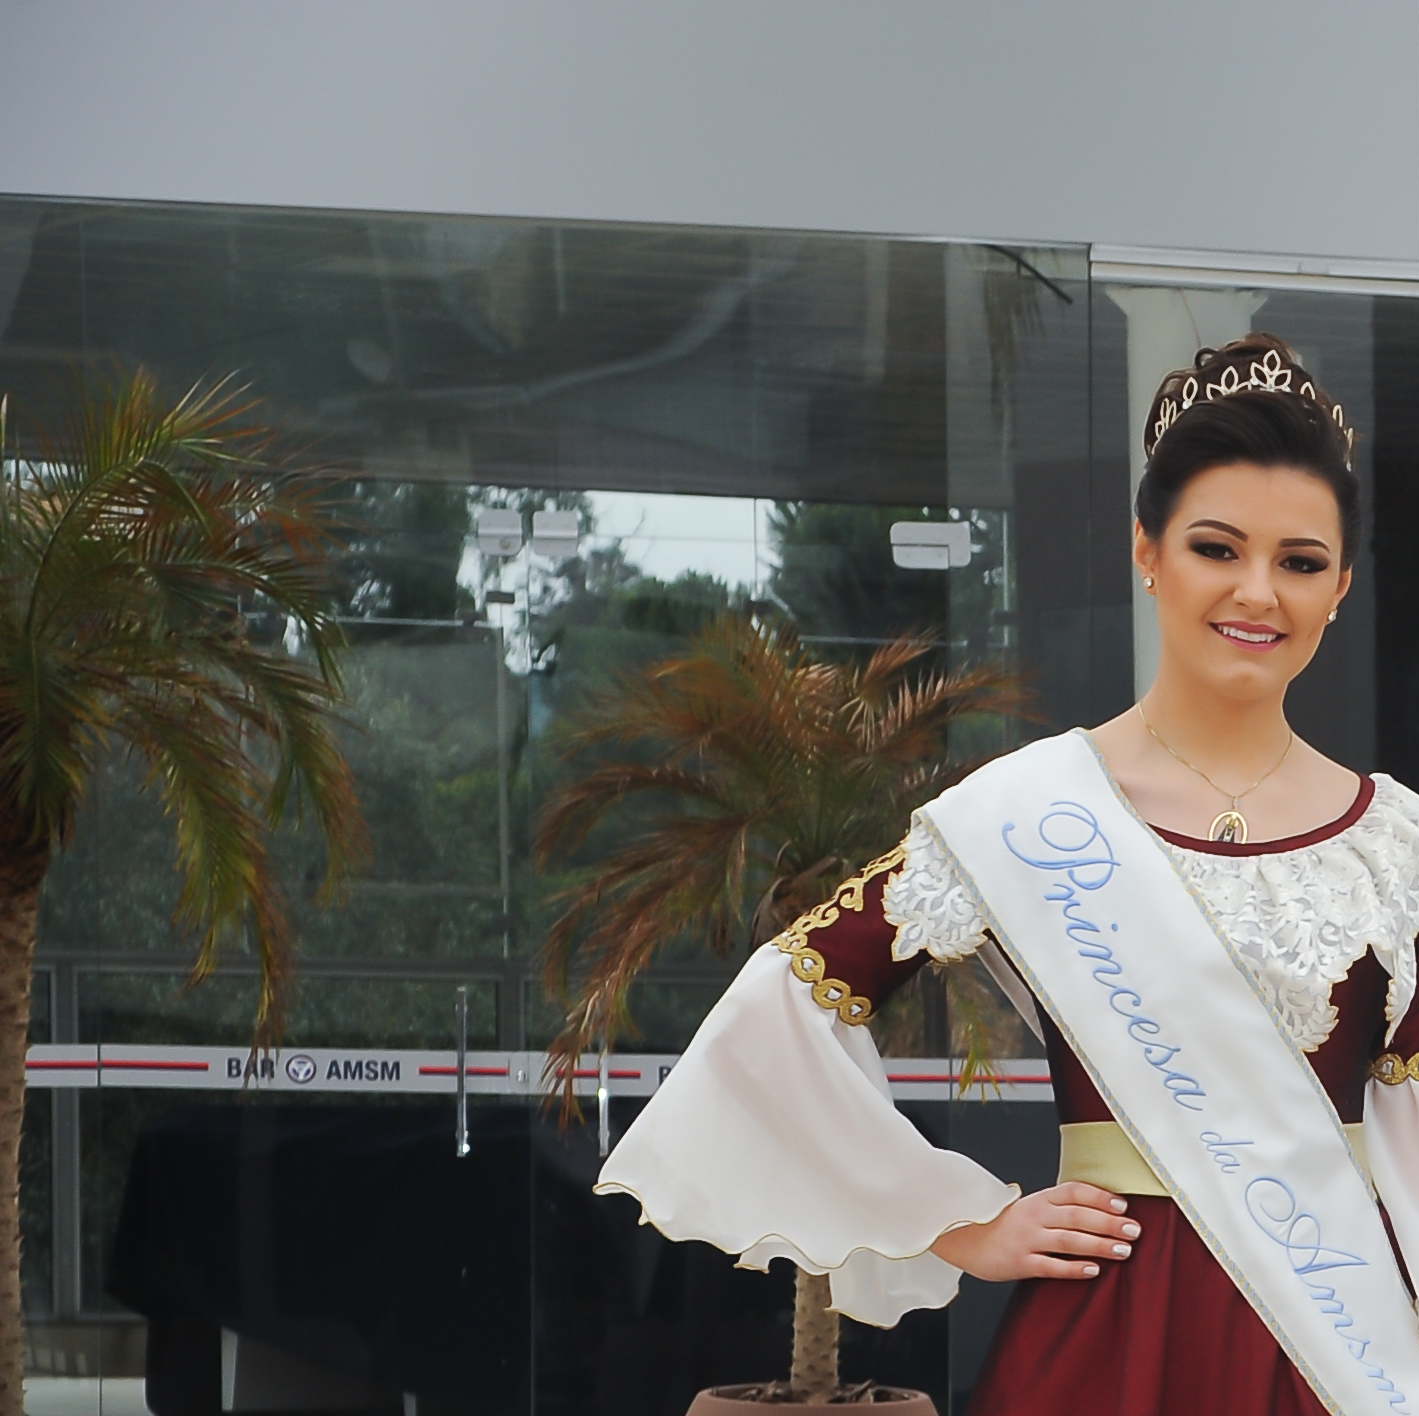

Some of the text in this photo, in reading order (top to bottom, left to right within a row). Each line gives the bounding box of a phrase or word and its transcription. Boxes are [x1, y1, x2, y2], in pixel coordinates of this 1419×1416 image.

[226, 1057, 400, 1082] BAR AMSM
[1002, 801, 1411, 1416] Princesa da Amsm
